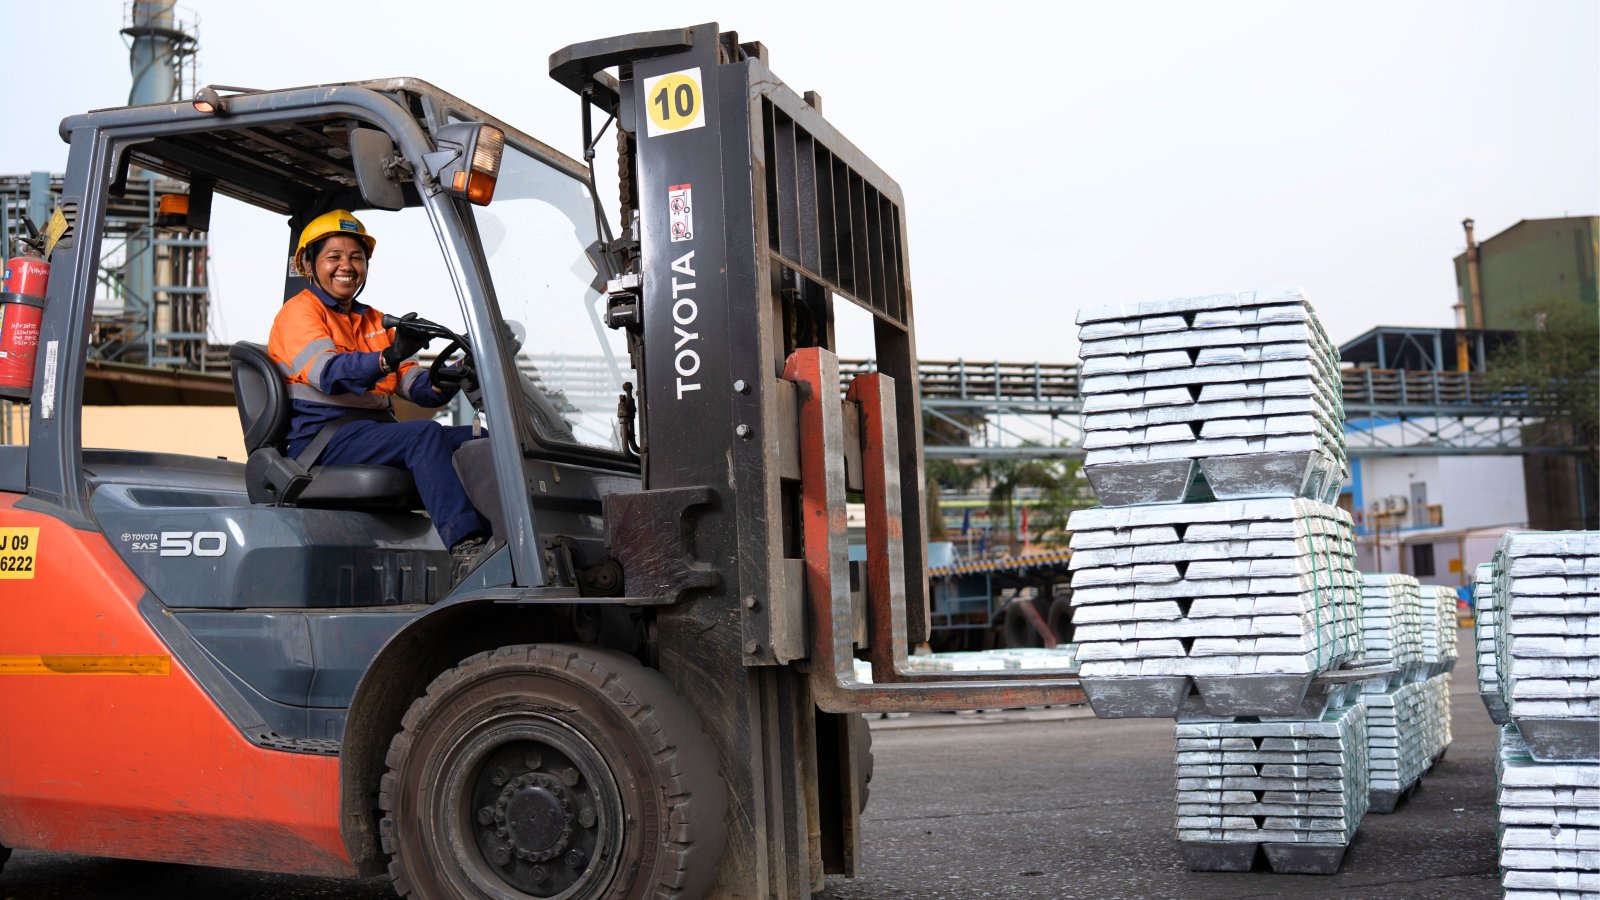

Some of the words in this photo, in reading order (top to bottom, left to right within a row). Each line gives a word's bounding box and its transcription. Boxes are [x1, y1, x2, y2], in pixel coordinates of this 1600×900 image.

[654, 83, 695, 121] 10
[671, 250, 702, 400] TOYOTA
[11, 535, 29, 551] 09
[131, 542, 158, 550] SAS
[132, 533, 158, 541] TOYOTA
[160, 531, 227, 557] 50
[0, 556, 33, 571] 6222
[641, 789, 658, 872] SOLIDEAL
